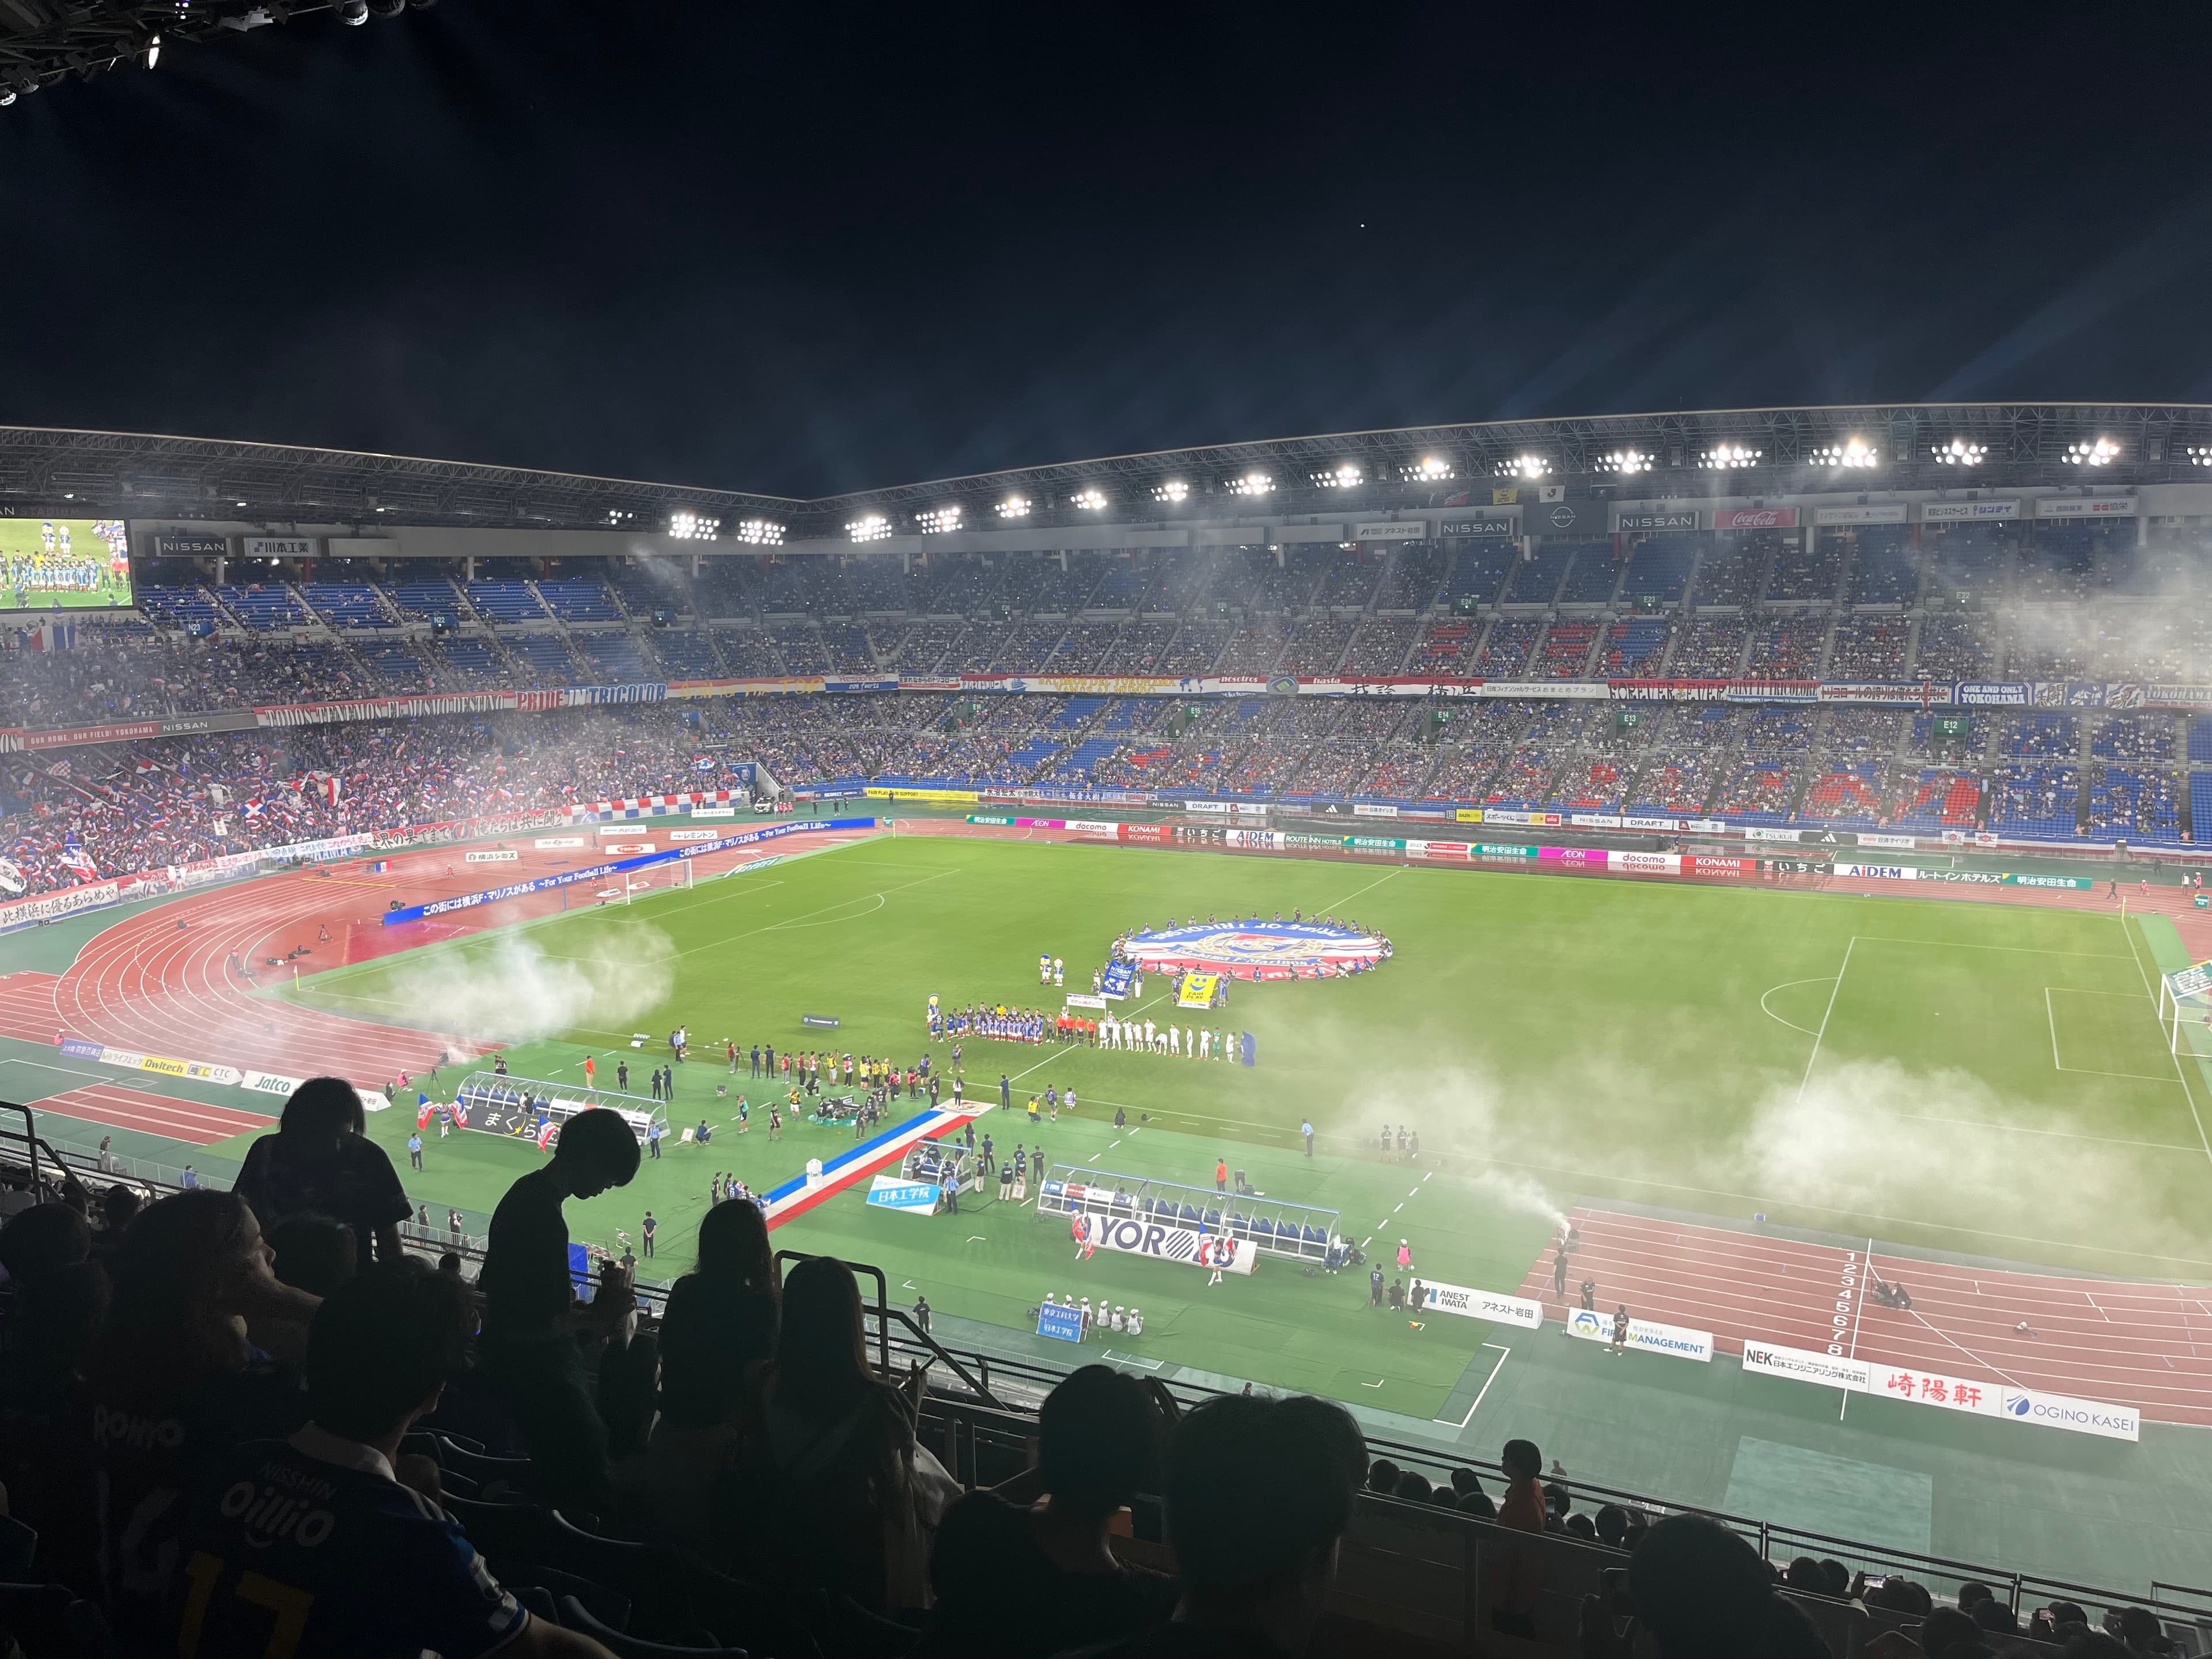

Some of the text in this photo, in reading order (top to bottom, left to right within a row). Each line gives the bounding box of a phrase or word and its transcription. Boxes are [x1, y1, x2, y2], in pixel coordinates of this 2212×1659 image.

[1443, 522, 1508, 533] NISSAN
[1622, 516, 1692, 528] NISSAN
[163, 542, 225, 551] NISSAN
[265, 541, 309, 552] 川本工業
[1039, 677, 1176, 687] SALIMOS DEL YOKOHAMA
[1221, 675, 1259, 683] nosotros
[1055, 685, 1093, 694] VAMOS
[1114, 685, 1156, 694] MUNDO
[1608, 683, 1675, 700] FOREVER
[1963, 685, 2024, 694] ONE AND ONLY
[516, 684, 668, 712] PRIDE IN TRICOLOR
[1961, 693, 2025, 704] YOKOHAMA
[264, 694, 505, 727] TODOS TENEMOS EL MISMO DESTINO
[162, 721, 209, 732] NISSAN
[31, 736, 45, 745] OUR
[73, 732, 88, 740] OUR
[115, 726, 154, 737] YOKOHAMA
[986, 788, 1016, 797] 水沼宏太
[1069, 791, 1100, 801] 飯倉大樹
[475, 809, 563, 835] 俺たちは共に闘う
[974, 816, 1007, 825] 明治安田生命
[1486, 813, 1515, 821] スポーツくじ
[786, 823, 809, 833] Football
[1075, 823, 1107, 831] docomo
[1127, 824, 1161, 834] KONAMI
[1187, 828, 1221, 838] いちご
[1354, 838, 1396, 847] 明治安田生命
[1482, 845, 1527, 855] 明治安田生命
[478, 852, 516, 860] 横浜シミズ
[1622, 853, 1666, 863] docomo
[1695, 857, 1740, 868] KONAMI
[1778, 862, 1825, 874] いちご
[558, 874, 573, 884] Your
[574, 868, 599, 880] Football
[2017, 876, 2077, 888] 明治安田生命
[1111, 965, 1132, 975] NISSAN
[112, 1054, 143, 1066] ライフエッグ
[144, 1059, 184, 1074] Owltech
[214, 1066, 230, 1078] CTC
[254, 1075, 290, 1093] Jatco
[878, 1186, 931, 1203] 日本工学院
[1846, 1252, 1855, 1262] 1
[1843, 1263, 1857, 1274] 2
[1840, 1276, 1855, 1286] 3
[1439, 1289, 1471, 1302] ANEST
[1838, 1289, 1853, 1300] 4
[1441, 1297, 1468, 1309] IWATA
[1836, 1301, 1850, 1312] 5
[1043, 1308, 1079, 1321] 東京工科大学
[1482, 1301, 1533, 1319] アネスト岩田
[1833, 1315, 1848, 1326] 6
[1045, 1324, 1074, 1337] 日本工学院
[1831, 1328, 1846, 1340] 7
[1628, 1332, 1705, 1354] MANAGEMENT
[1827, 1344, 1843, 1356] 8
[1746, 1349, 1773, 1366] NEK
[1773, 1359, 1866, 1384] 日本エンジニアリング株式会社
[1887, 1372, 1982, 1407] 崎陽軒
[2033, 1404, 2134, 1431] OGINO KASEI
